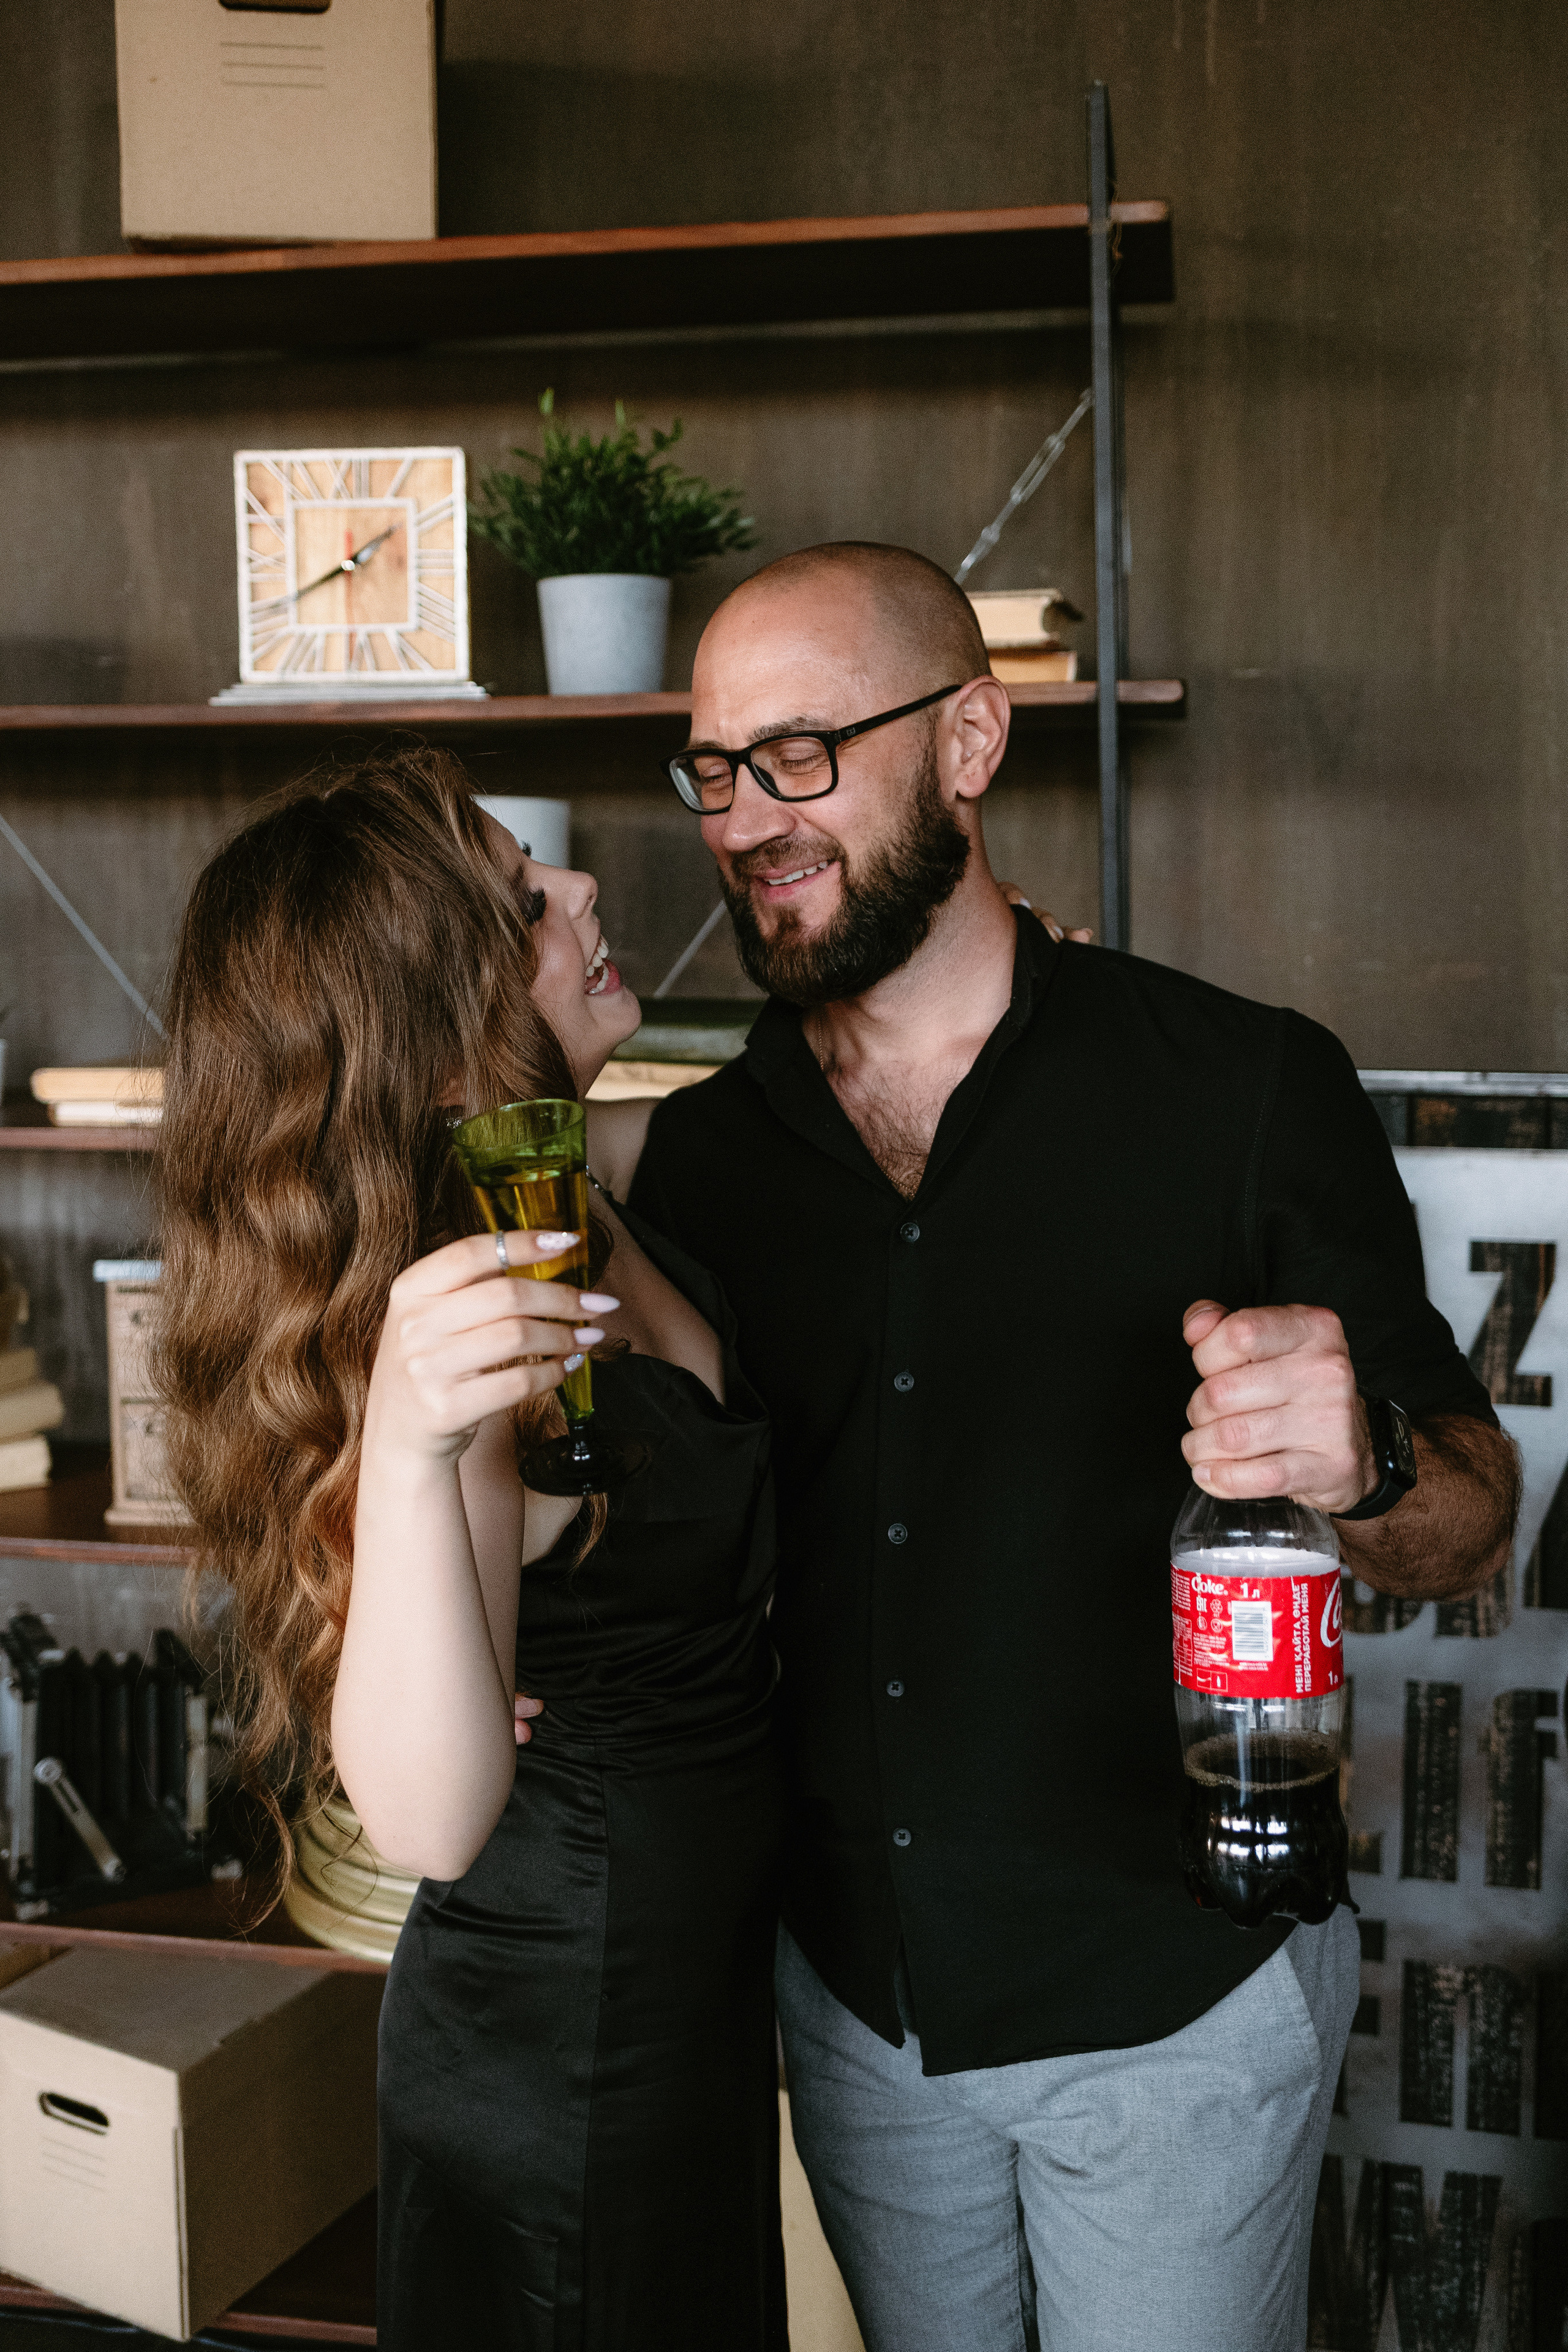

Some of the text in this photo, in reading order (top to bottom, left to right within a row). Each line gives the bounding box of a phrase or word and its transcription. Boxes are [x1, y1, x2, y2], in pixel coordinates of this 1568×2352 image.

[1240, 1582, 1249, 1599] 1
[1300, 1583, 1312, 1692] ПЕРЕРАБОТАЙ МЕНЯ
[1294, 1664, 1304, 1694] МЕНІ
